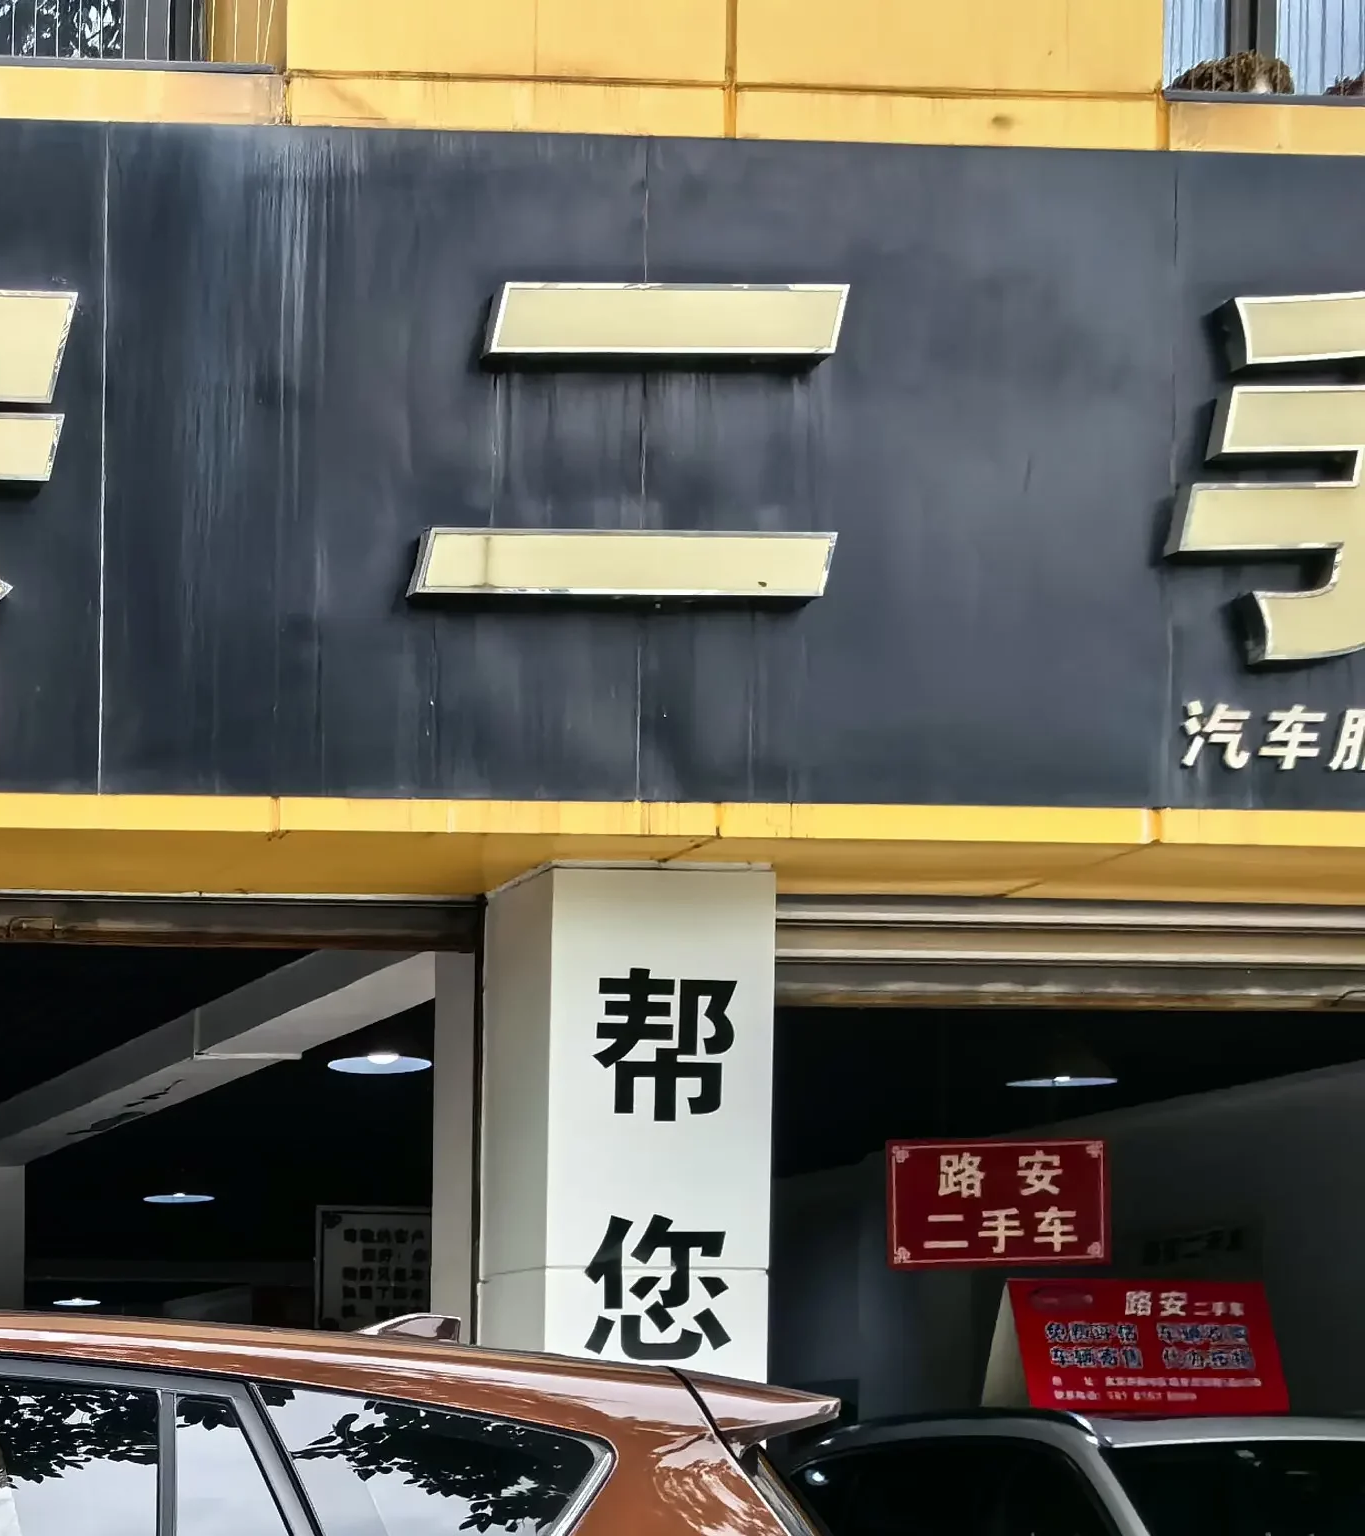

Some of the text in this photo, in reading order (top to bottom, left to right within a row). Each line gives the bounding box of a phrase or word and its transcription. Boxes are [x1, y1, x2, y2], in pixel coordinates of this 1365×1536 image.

[584, 967, 738, 1361] 帮您
[937, 1150, 1063, 1198] 路安
[923, 1206, 1079, 1254] 二手车
